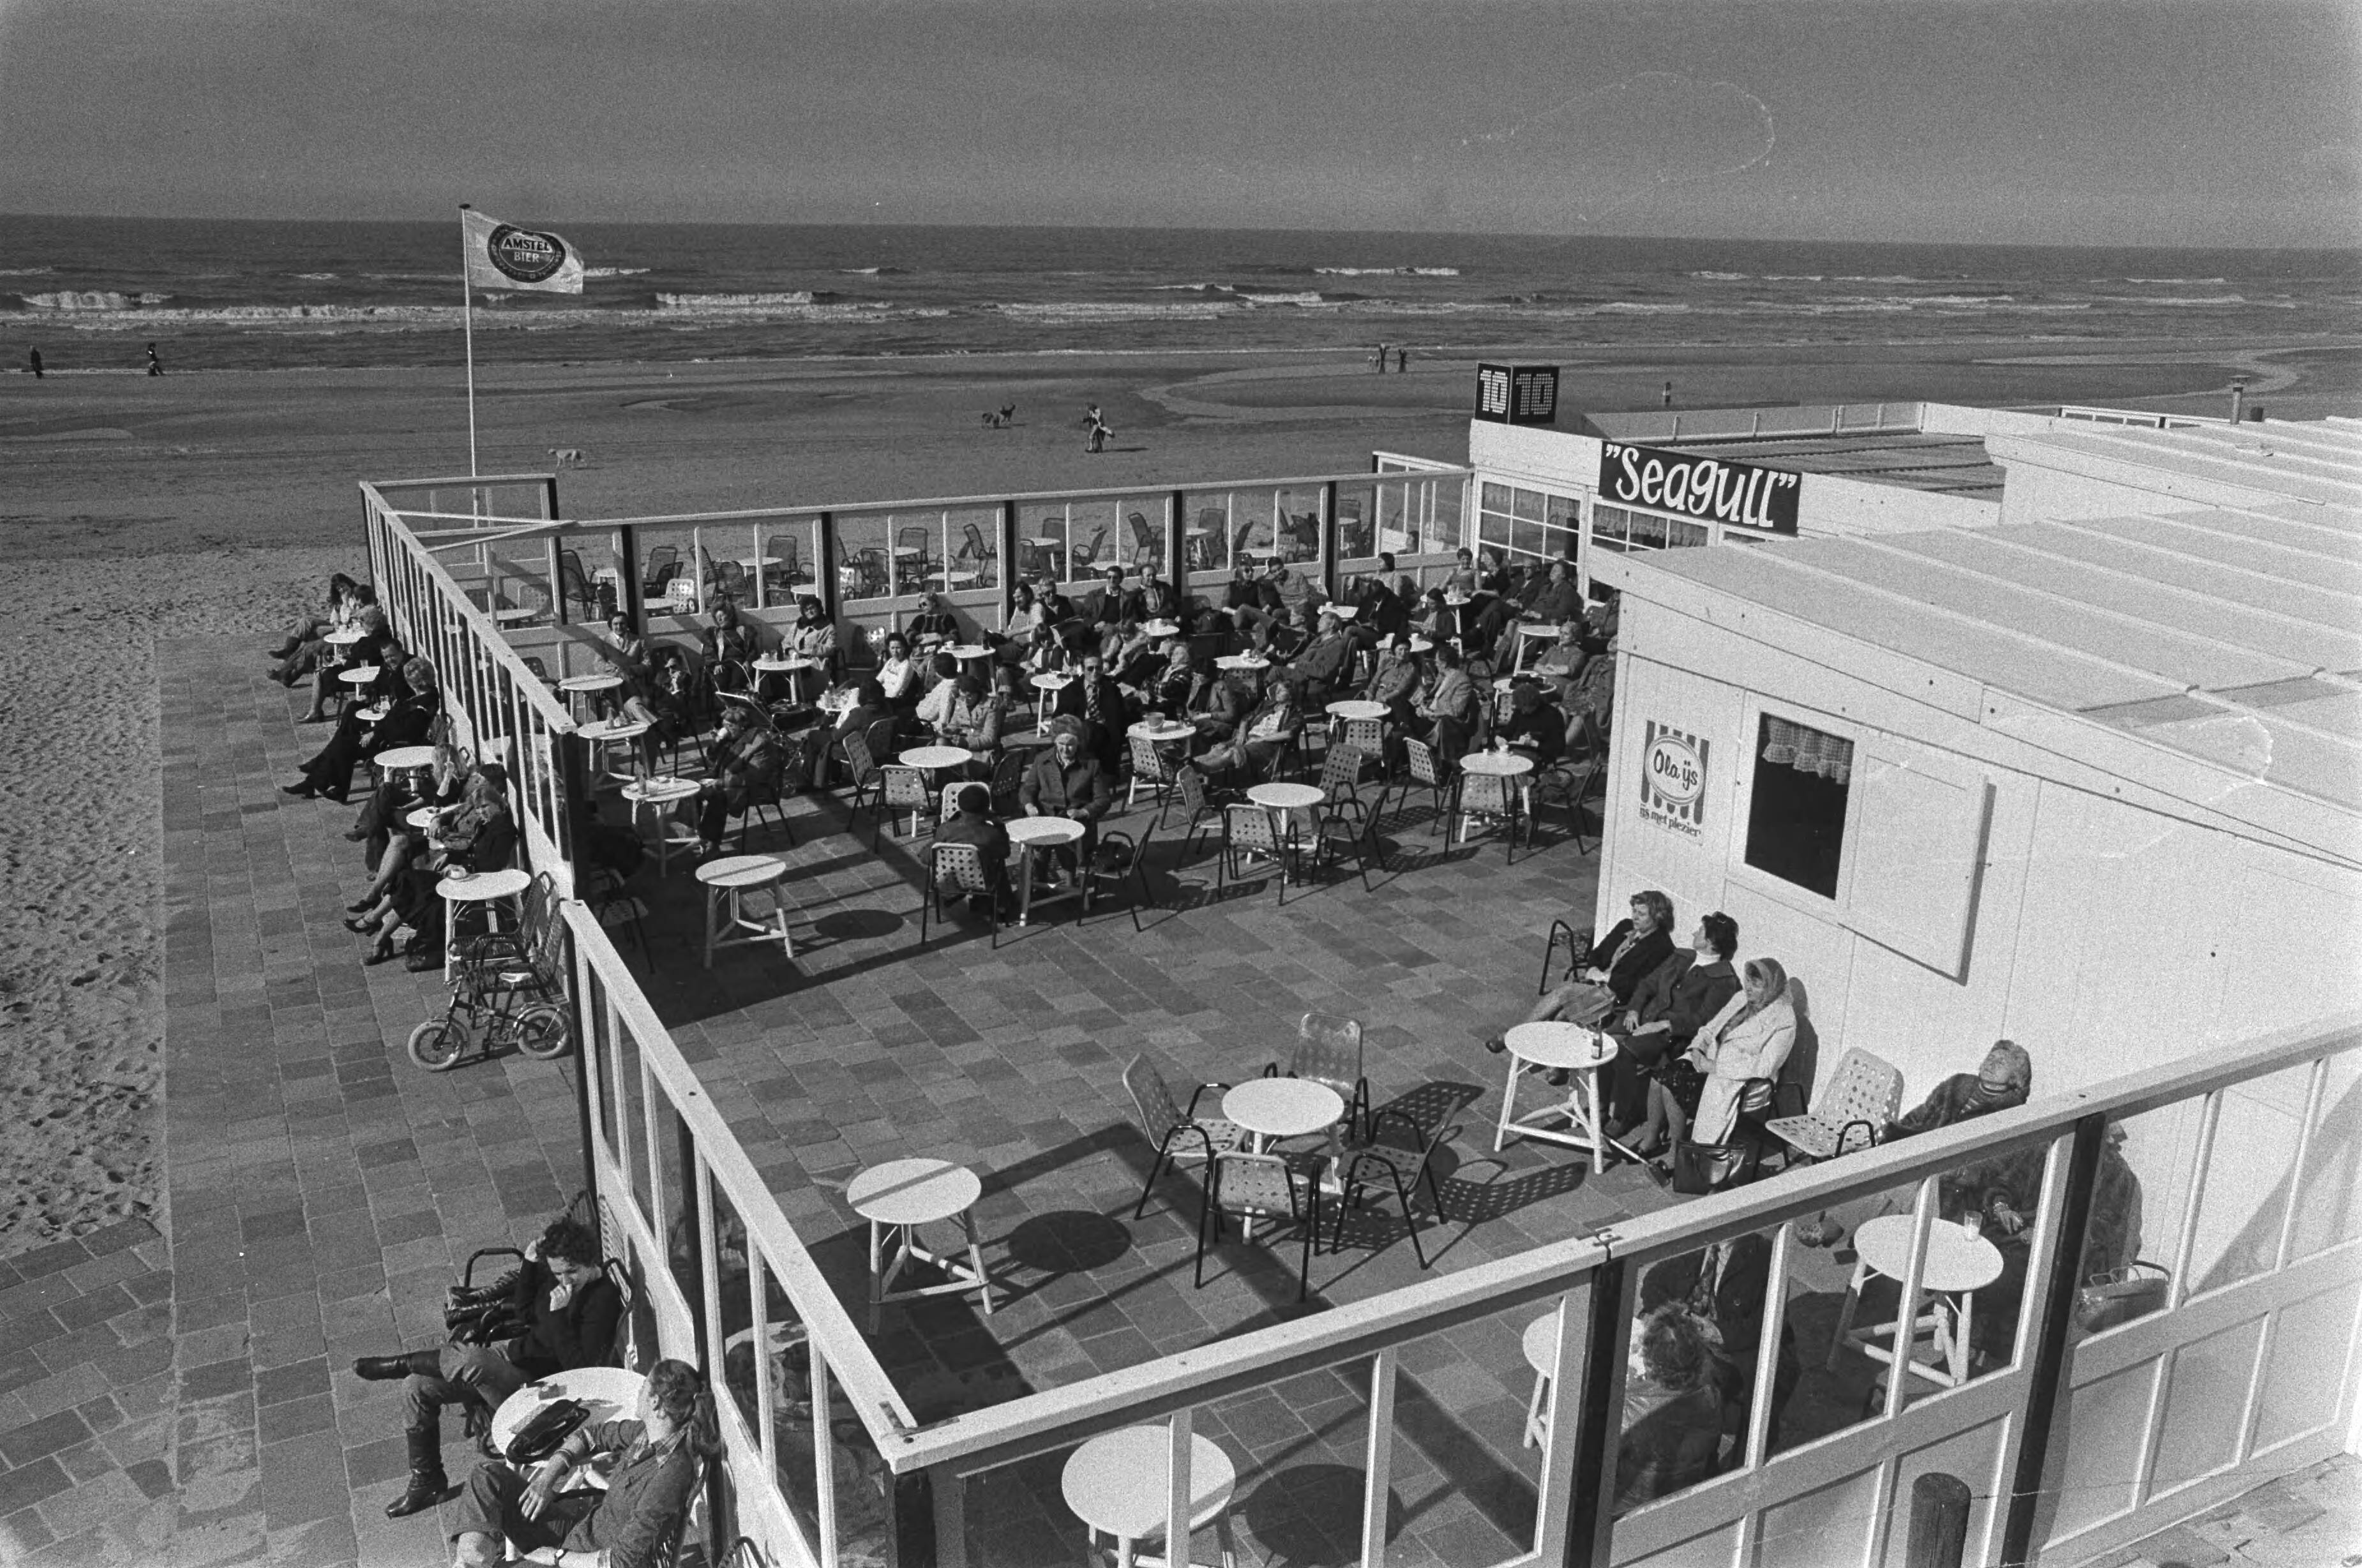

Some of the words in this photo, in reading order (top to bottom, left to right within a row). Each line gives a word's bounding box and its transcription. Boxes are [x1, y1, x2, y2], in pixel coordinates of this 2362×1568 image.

[504, 238, 550, 251] AMSTEL
[514, 251, 539, 263] BIER
[1480, 370, 1508, 414] 10
[1516, 373, 1554, 415] 10
[1654, 749, 1680, 779] Ola
[1651, 811, 1667, 825] met
[1668, 817, 1701, 837] plezier
